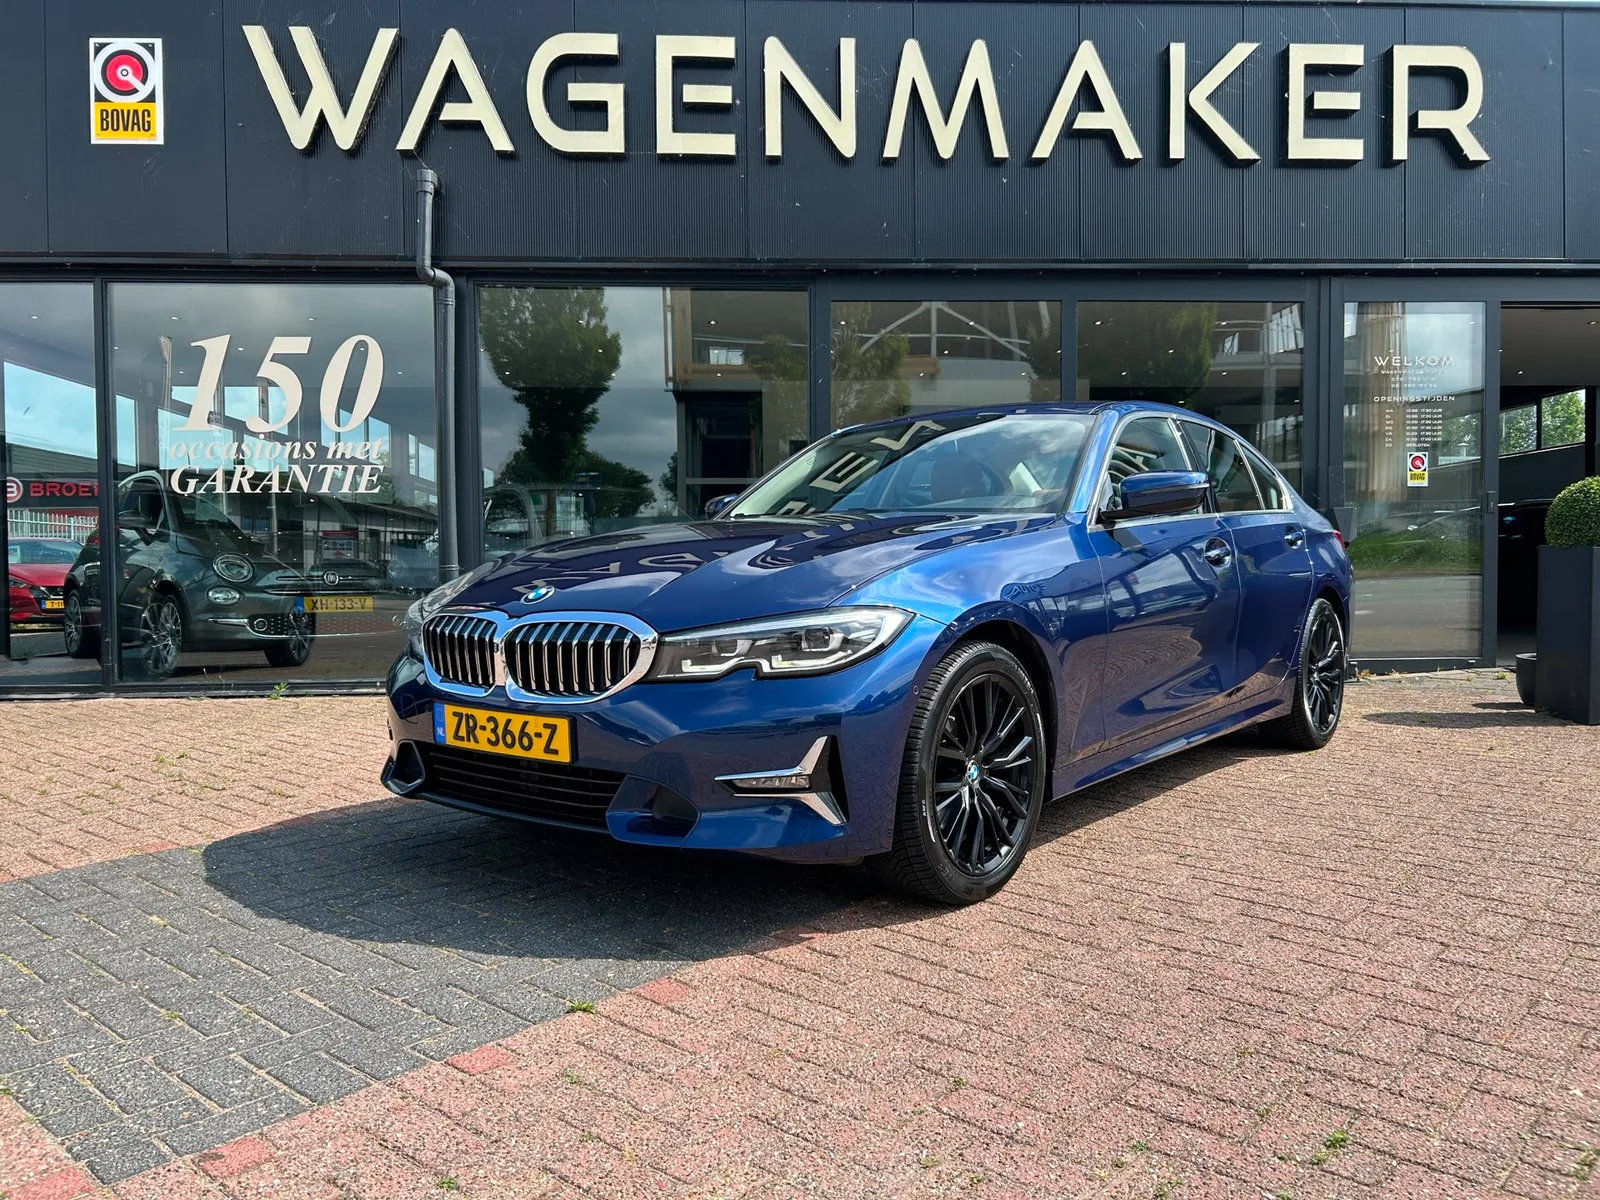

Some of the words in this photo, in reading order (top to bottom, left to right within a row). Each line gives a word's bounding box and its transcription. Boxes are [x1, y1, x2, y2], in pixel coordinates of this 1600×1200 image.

[241, 24, 1491, 163] WAGENMAKER
[100, 108, 151, 132] BOVAG
[1374, 356, 1454, 366] WELKOM
[170, 334, 384, 433] 150
[169, 433, 317, 460] occasions
[326, 437, 383, 460] met
[170, 464, 384, 495] GARANTIE
[1410, 472, 1425, 480] BOVAG
[311, 598, 367, 611] XH-133-V
[452, 711, 559, 755] ZR-366-Z
